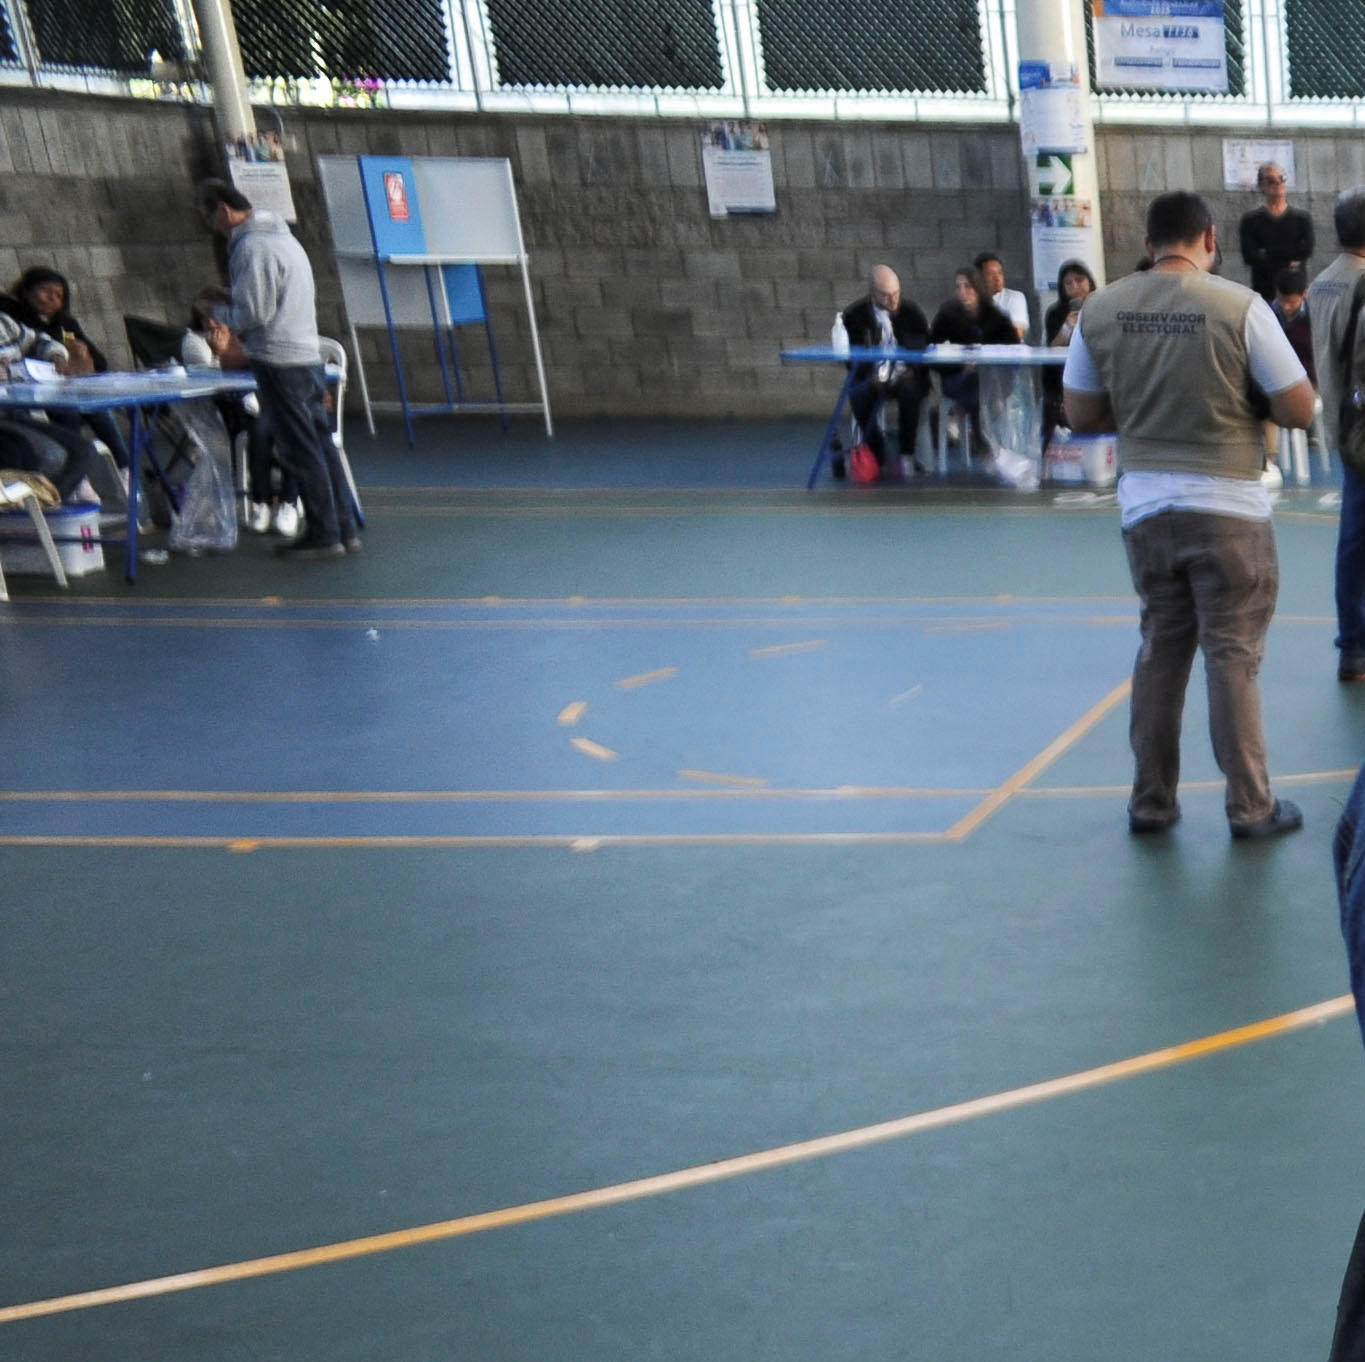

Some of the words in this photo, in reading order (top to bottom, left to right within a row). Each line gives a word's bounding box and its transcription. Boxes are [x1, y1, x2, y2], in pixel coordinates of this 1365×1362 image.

[1120, 23, 1160, 39] Mesa
[1116, 311, 1207, 325] OBSERVADOR
[1122, 322, 1199, 336] ELECTORAL
